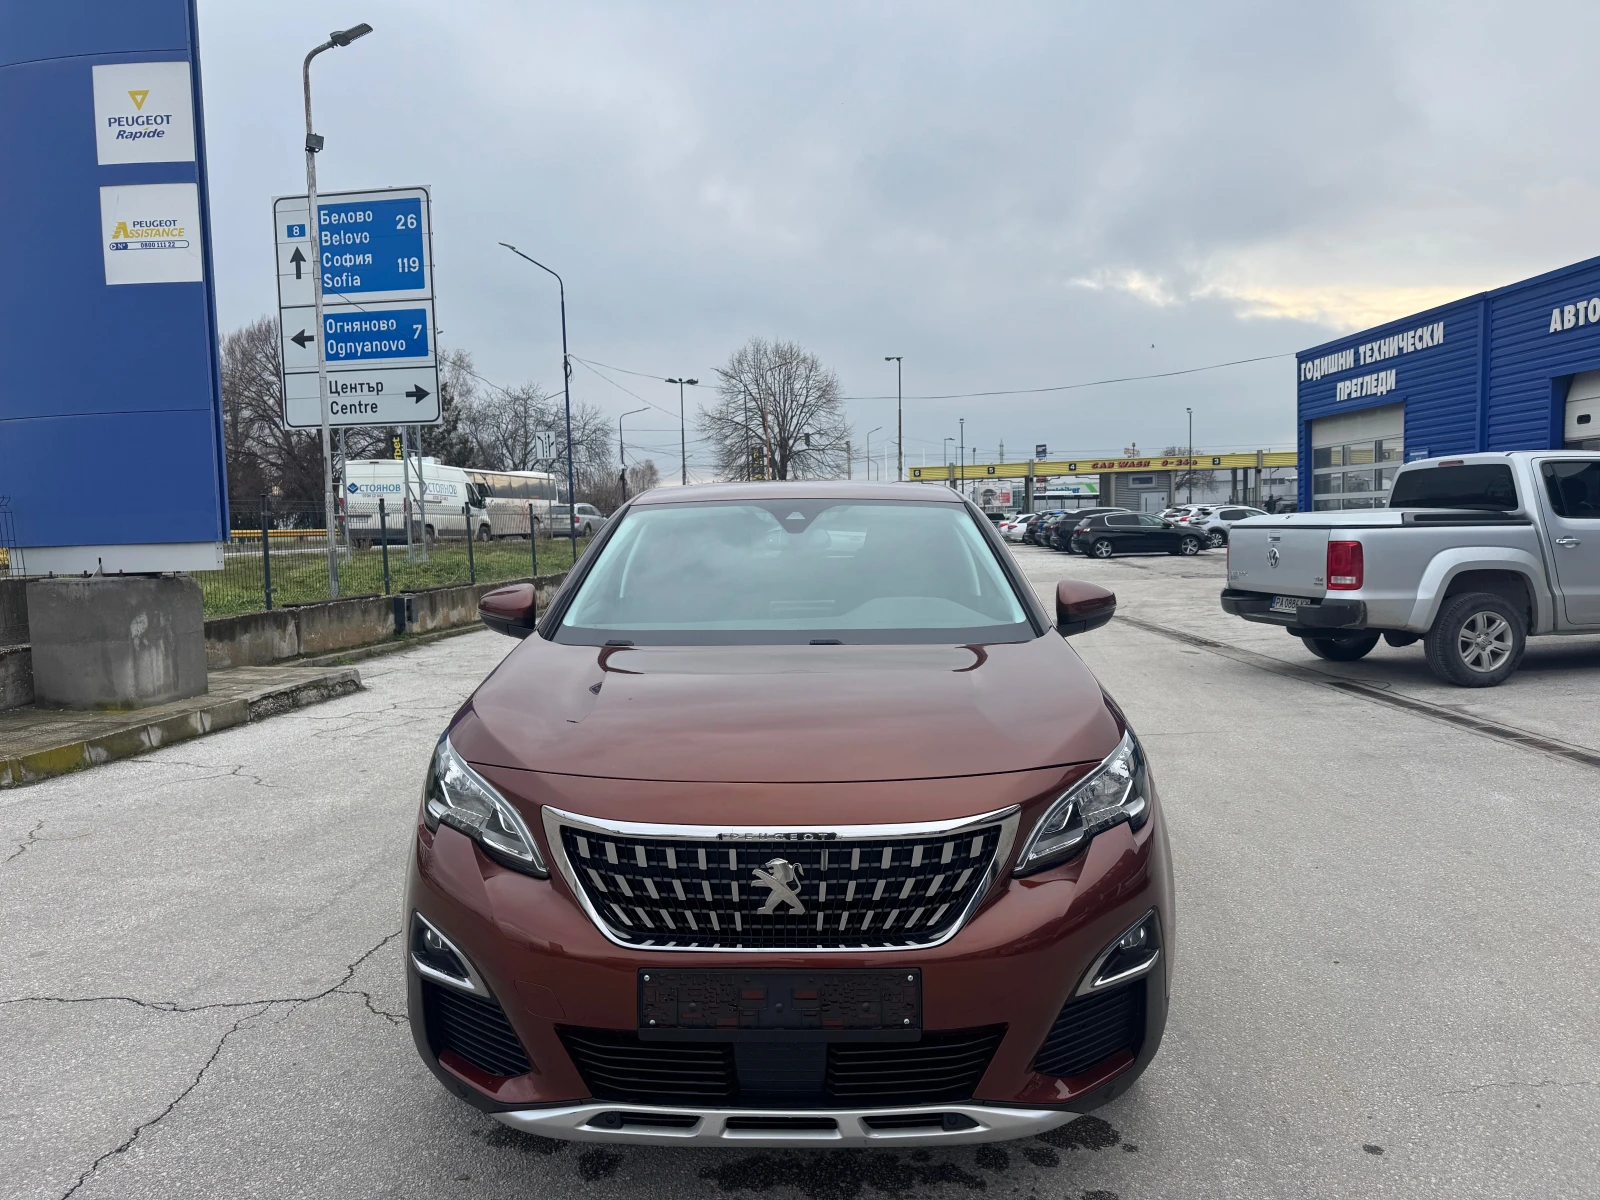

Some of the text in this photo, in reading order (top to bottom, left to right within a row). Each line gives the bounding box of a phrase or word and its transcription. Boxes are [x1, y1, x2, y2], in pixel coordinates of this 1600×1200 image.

[108, 115, 172, 127] PEUGEOT
[133, 219, 178, 228] PEUGEOT
[320, 210, 417, 230] Белово 26
[111, 221, 185, 239] ASSISTANCE
[292, 226, 300, 236] 8
[321, 230, 370, 246] Belovo
[322, 252, 419, 273] София 119
[323, 273, 361, 288] Sofia
[326, 318, 422, 340] Огняново 7
[327, 340, 406, 358] Ognyanovo
[1301, 321, 1444, 381] ГОДИШНИ ТЕХНИЧЕСКИ
[329, 380, 384, 395] Център
[1336, 368, 1396, 401] ПРЕГЛЕДИ
[330, 400, 378, 415] Centre
[1091, 461, 1115, 469] CAR
[1118, 460, 1151, 468] WASH
[359, 484, 401, 493] СТОЯНОВ
[428, 482, 457, 495] СТОЯНОВ
